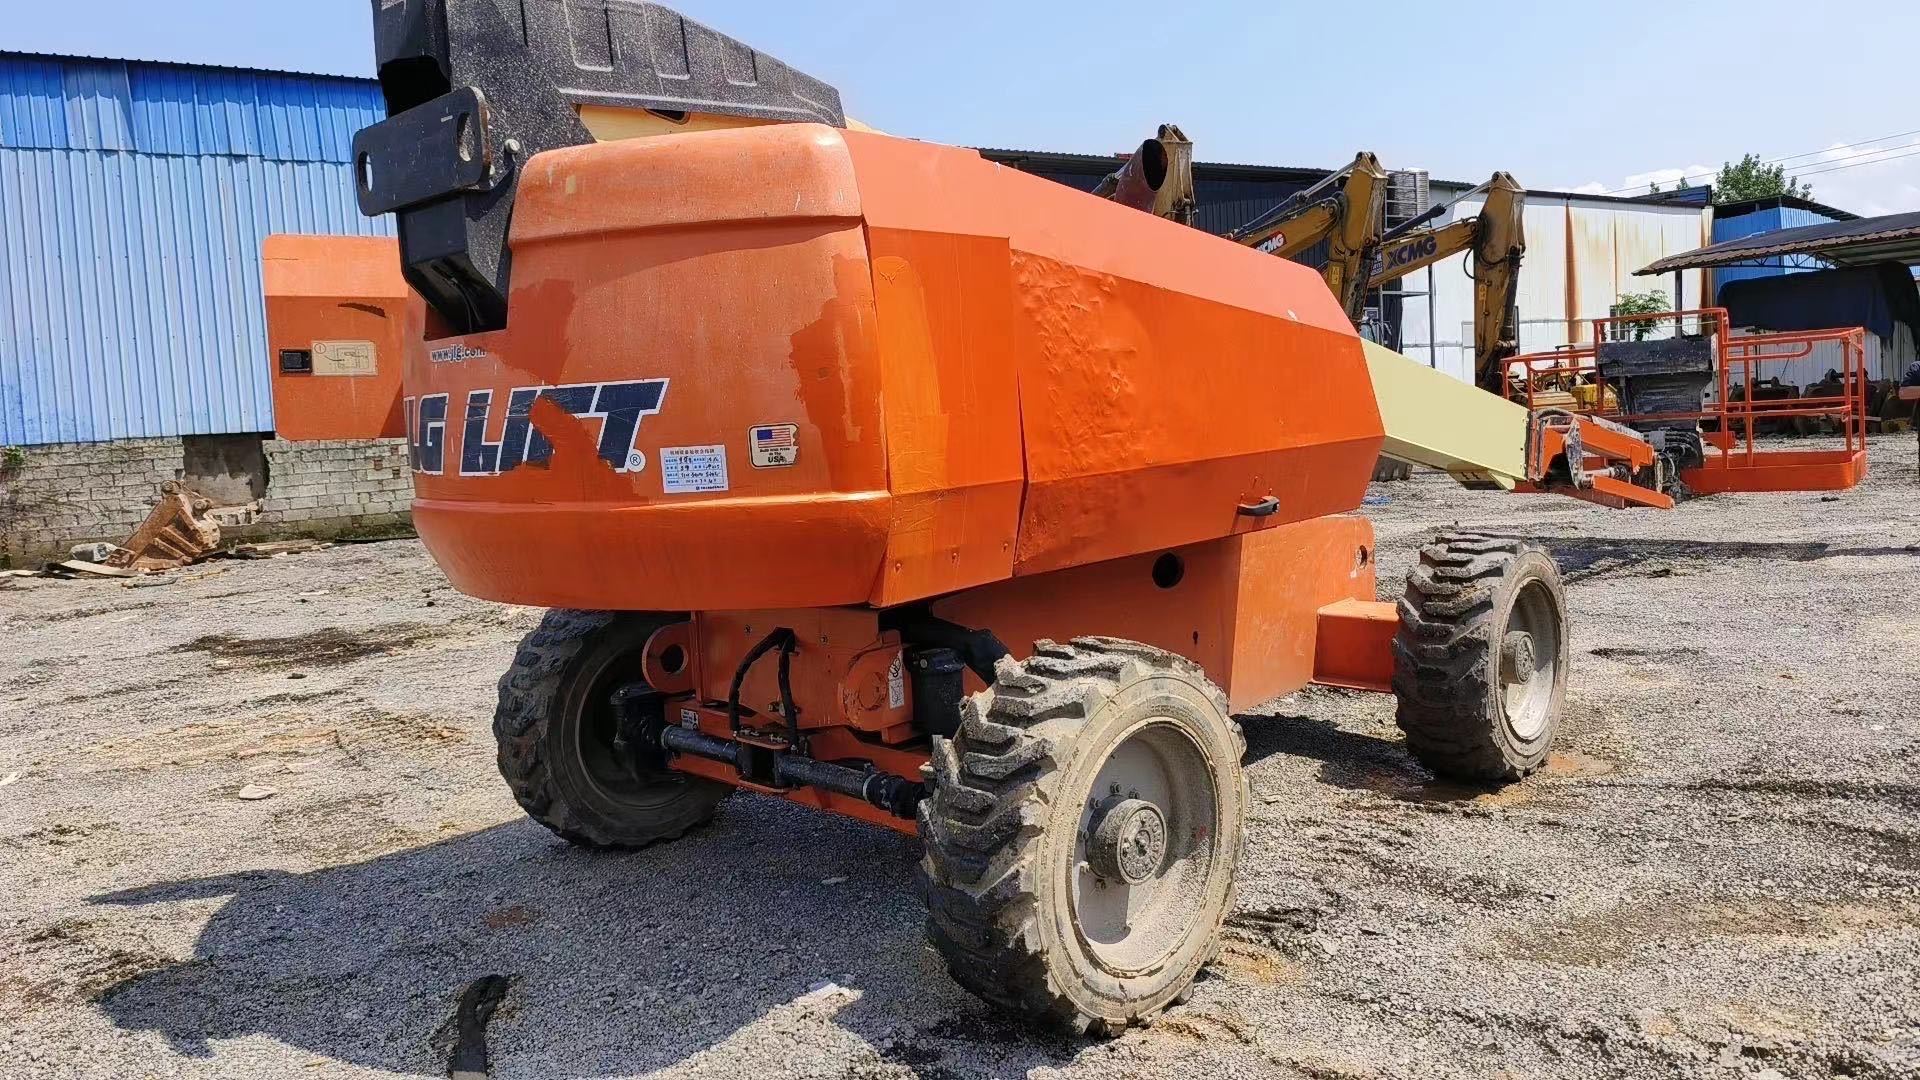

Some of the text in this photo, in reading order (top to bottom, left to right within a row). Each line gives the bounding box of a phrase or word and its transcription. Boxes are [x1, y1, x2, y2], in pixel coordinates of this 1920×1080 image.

[1387, 235, 1437, 271] XCMG
[431, 345, 486, 362] www.jlg.com
[767, 455, 787, 464] USA
